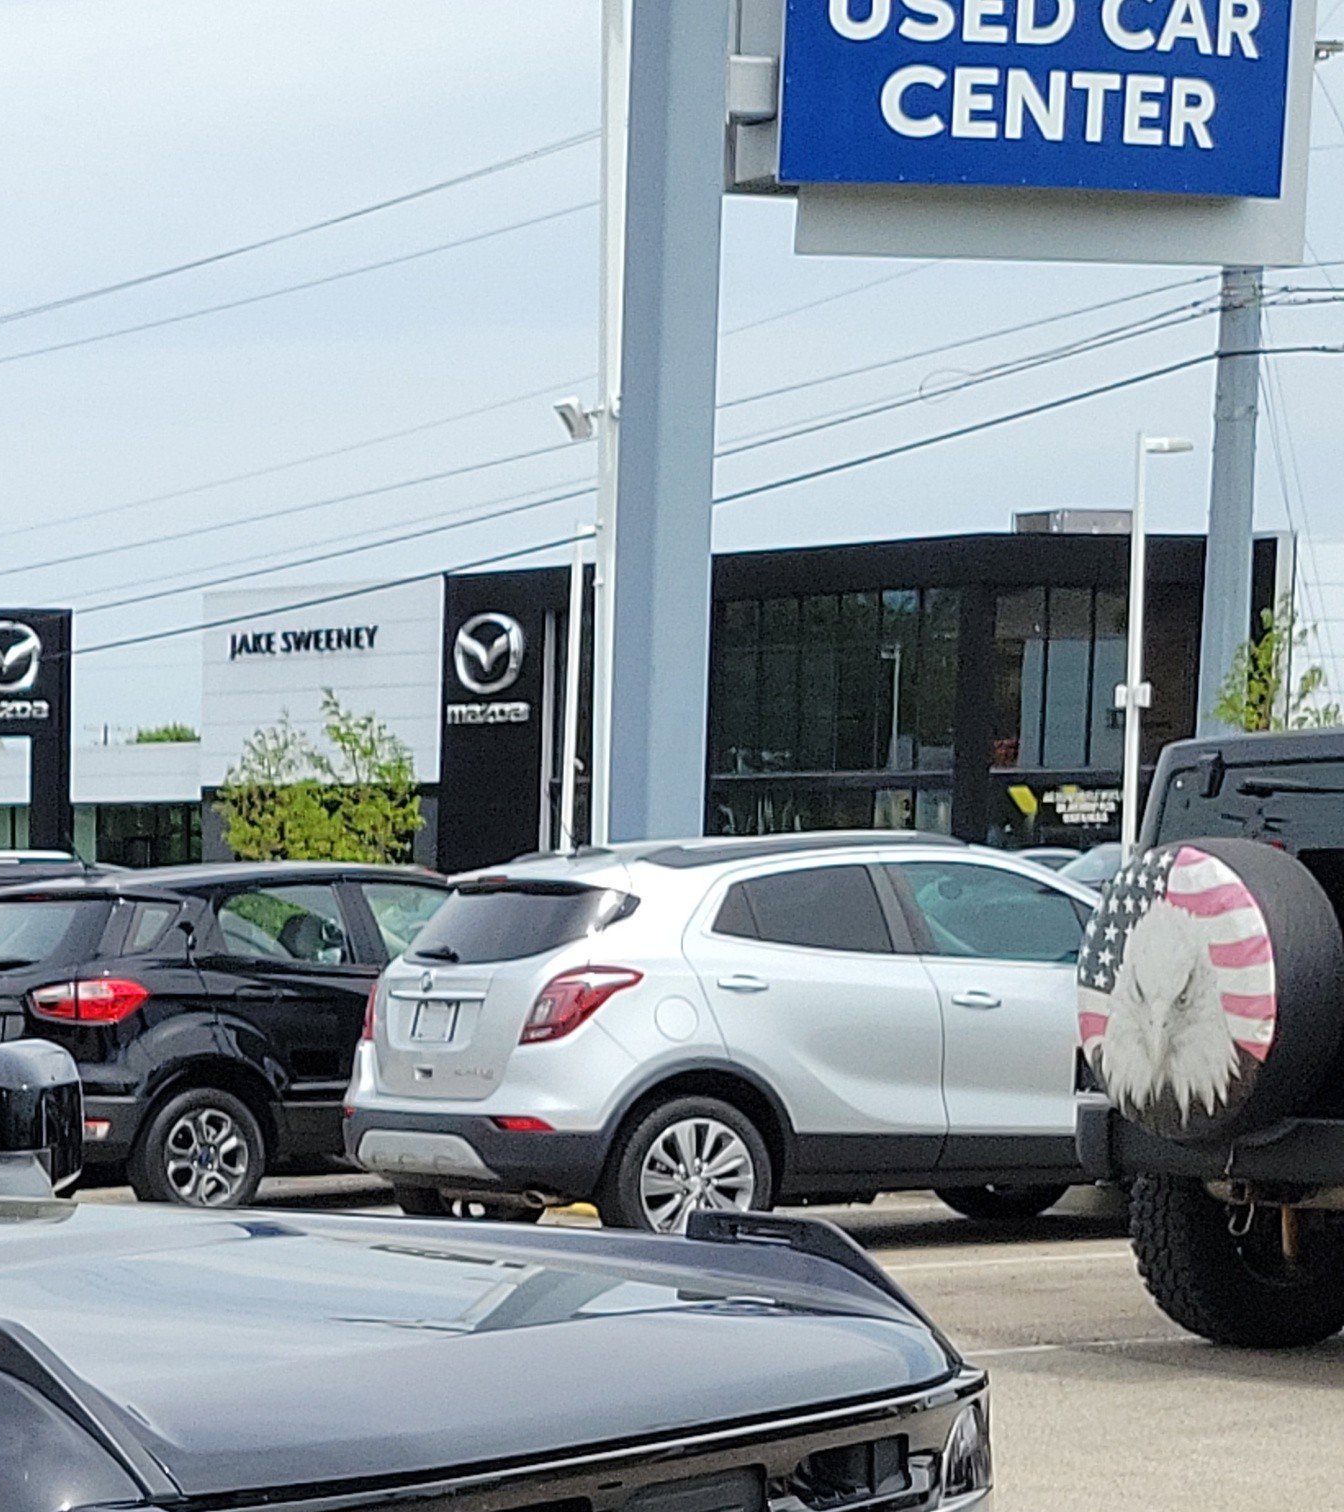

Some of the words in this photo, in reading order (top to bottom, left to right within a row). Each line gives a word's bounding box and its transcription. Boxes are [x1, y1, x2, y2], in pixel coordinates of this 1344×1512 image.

[827, 0, 1076, 44] USED
[1101, 0, 1261, 59] CAR
[879, 64, 1216, 149] CENTER
[229, 631, 276, 661] JAKE
[280, 624, 379, 653] SWEENEY
